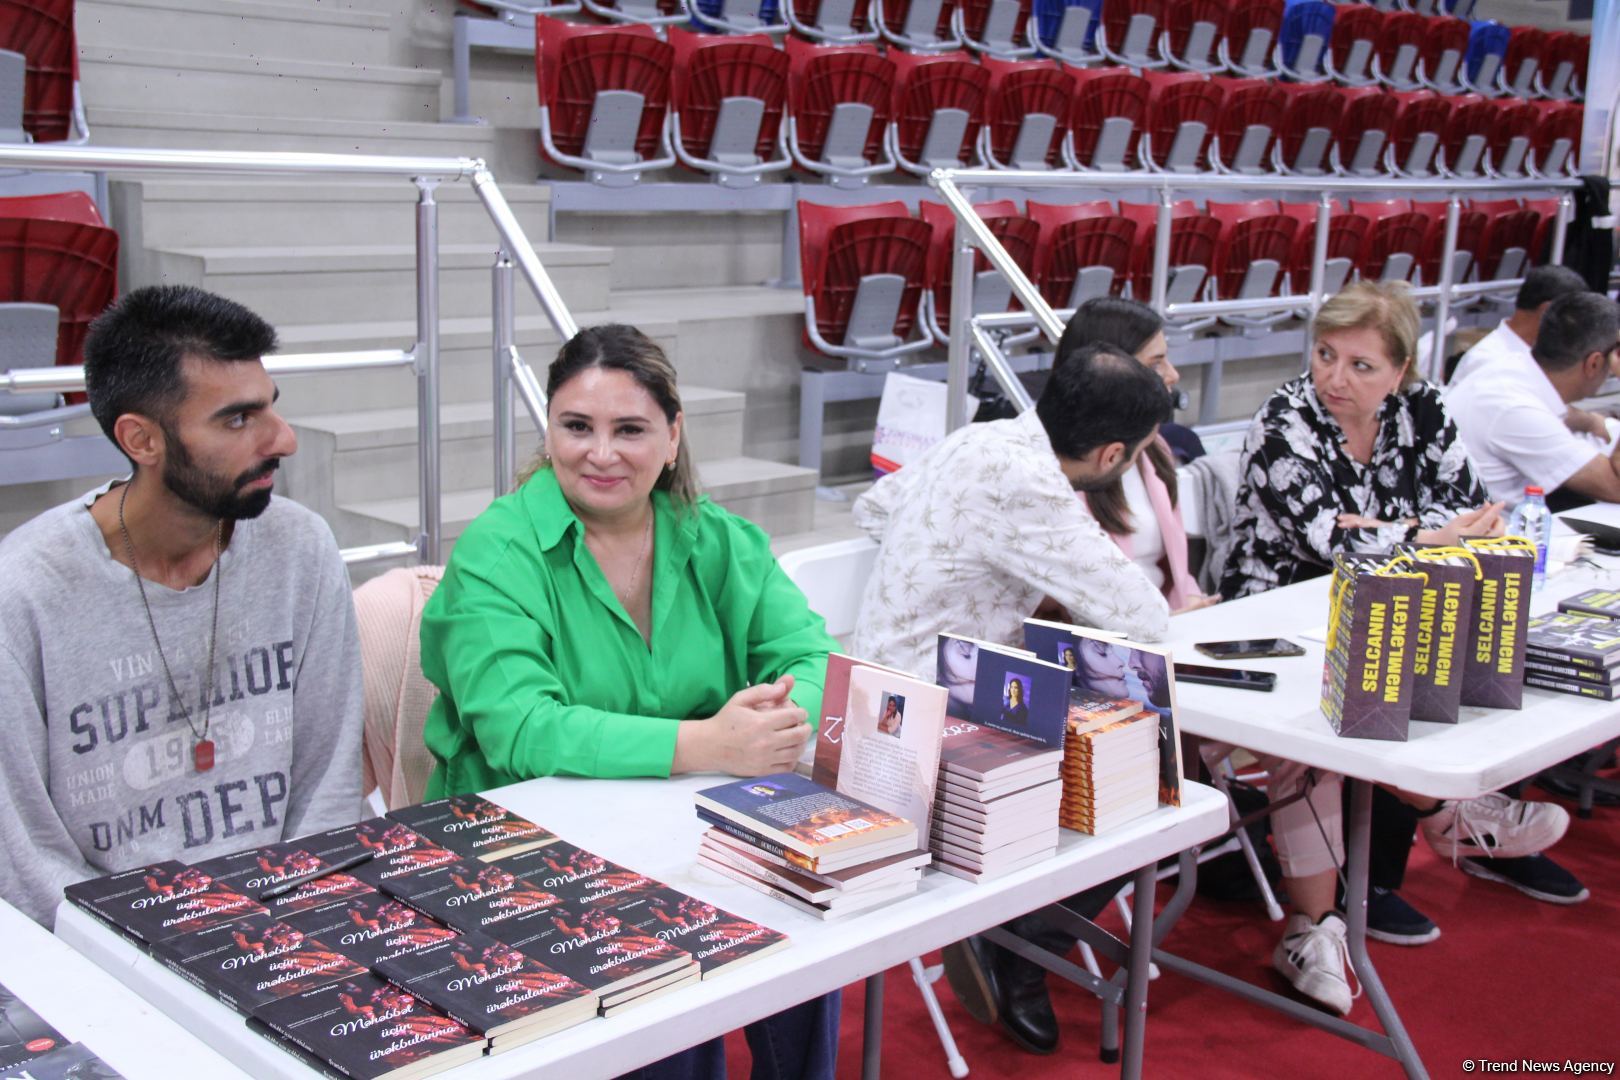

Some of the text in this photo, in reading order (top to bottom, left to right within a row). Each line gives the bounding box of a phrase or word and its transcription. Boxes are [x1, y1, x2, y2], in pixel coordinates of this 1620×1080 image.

[1362, 602, 1387, 693] SELCANIN
[1413, 588, 1438, 676] SELCANIN
[1476, 579, 1498, 664] SELCANIN
